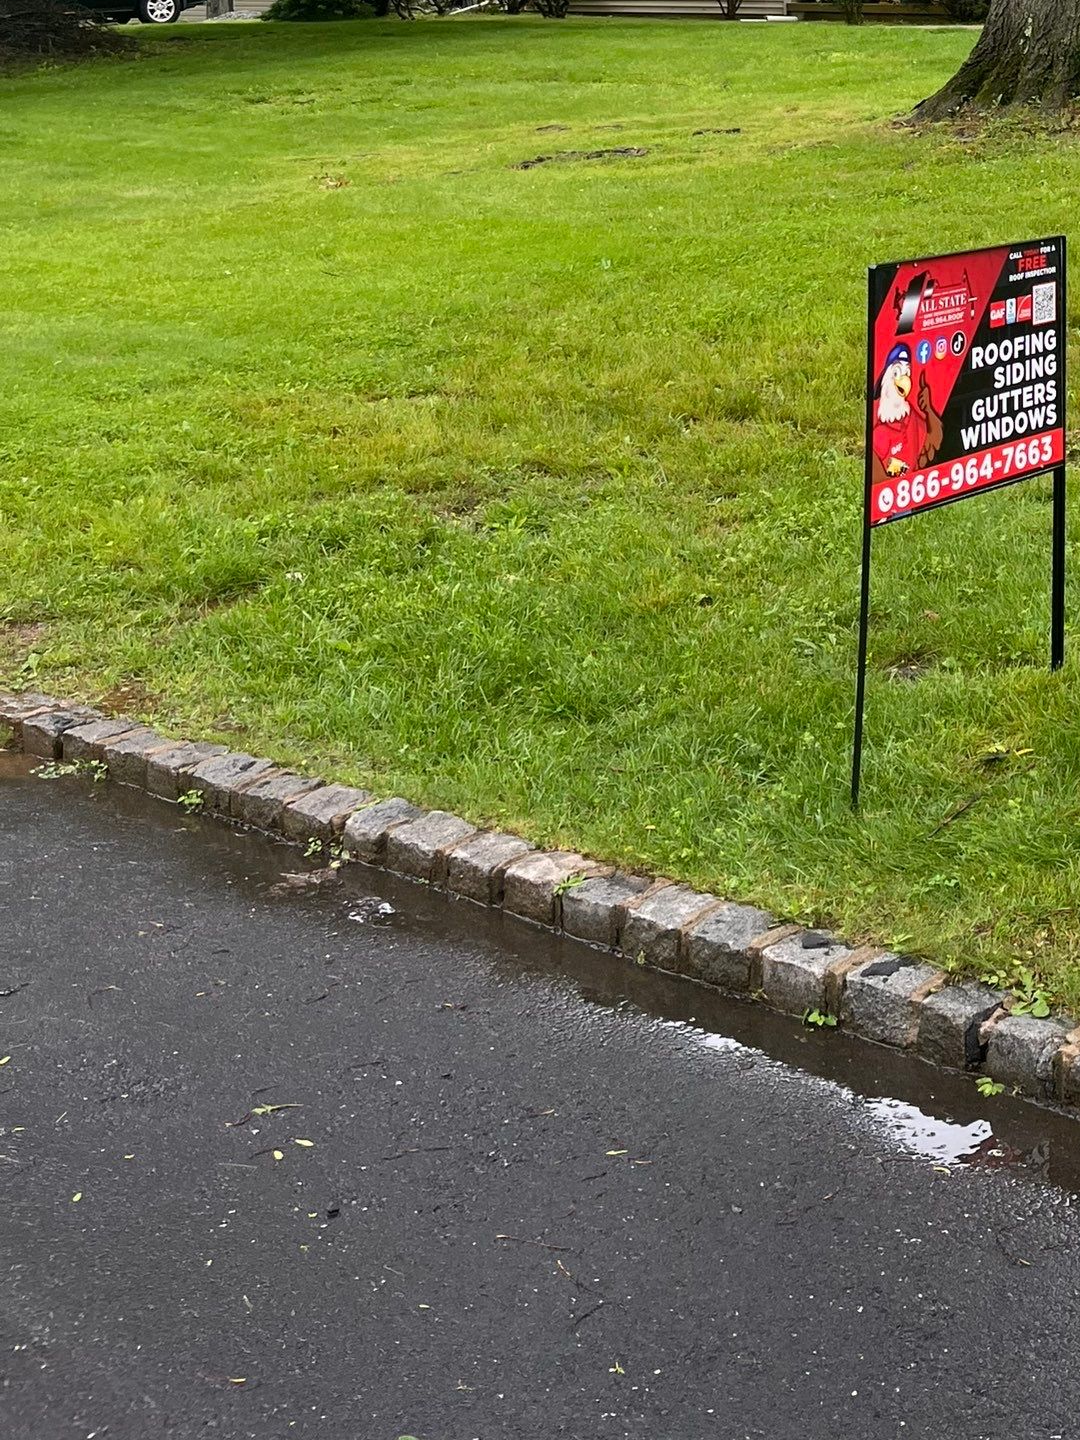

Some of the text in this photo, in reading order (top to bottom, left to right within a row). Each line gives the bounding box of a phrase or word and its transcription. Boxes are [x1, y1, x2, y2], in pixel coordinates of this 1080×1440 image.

[1009, 252, 1022, 260] CALL
[1040, 246, 1050, 254] FOR
[1019, 255, 1047, 271] FREE
[1009, 267, 1056, 282] ROOF INSPECTION
[920, 299, 937, 313] ALL
[939, 294, 966, 308] STATE
[991, 308, 1005, 320] GAF
[971, 329, 1057, 370] ROOFING
[993, 355, 1057, 389] SIDING
[971, 379, 1057, 422] GUTTERS
[960, 403, 1058, 451] WINDOWS
[896, 435, 1053, 509] 866-964-7663
